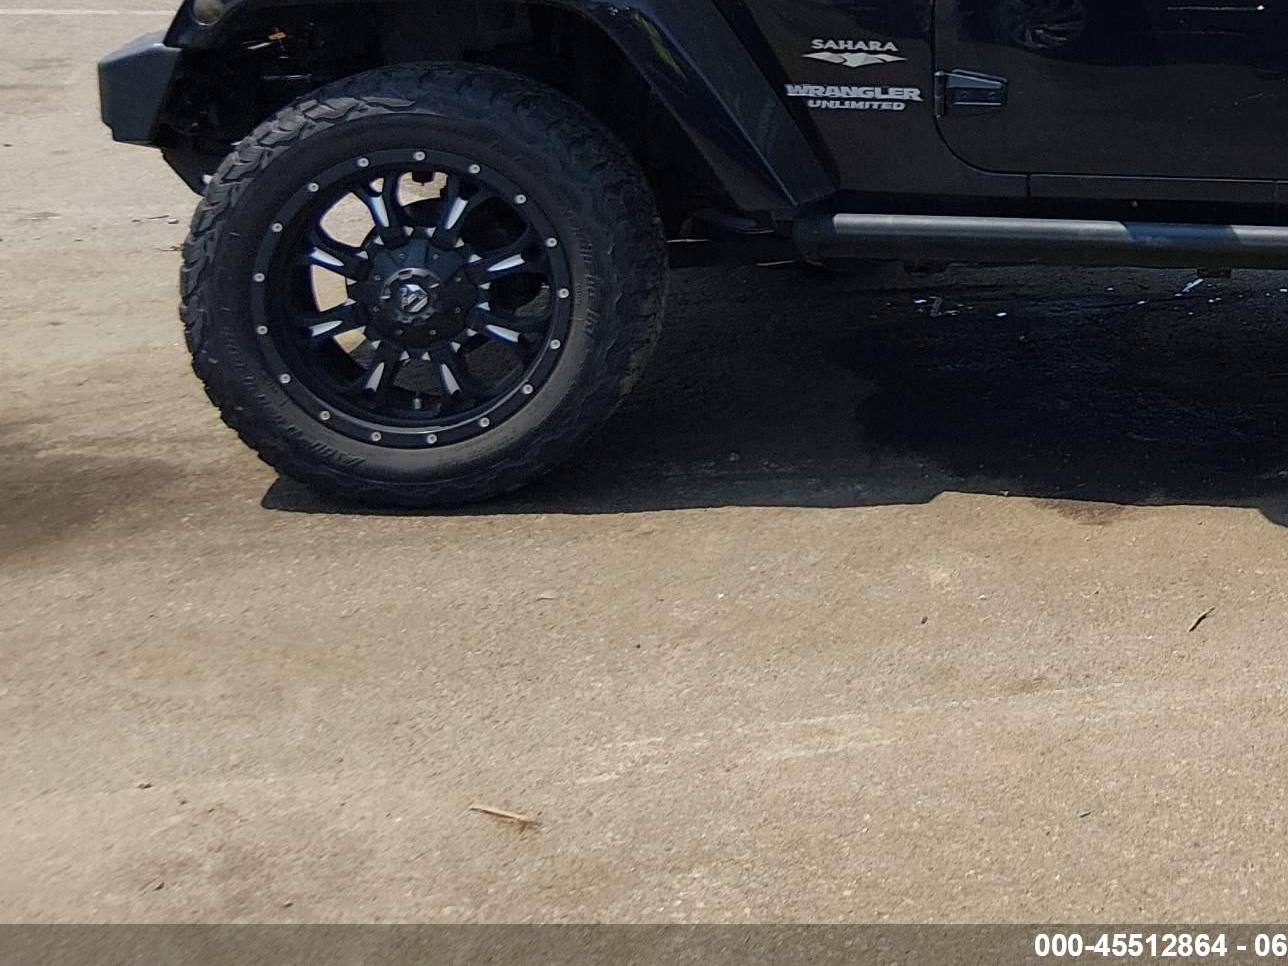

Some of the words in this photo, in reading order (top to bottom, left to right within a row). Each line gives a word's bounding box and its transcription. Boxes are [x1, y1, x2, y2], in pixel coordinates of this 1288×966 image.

[811, 38, 899, 52] SAHARA
[784, 84, 923, 101] WRANGLER
[807, 100, 907, 111] UNLIMITED
